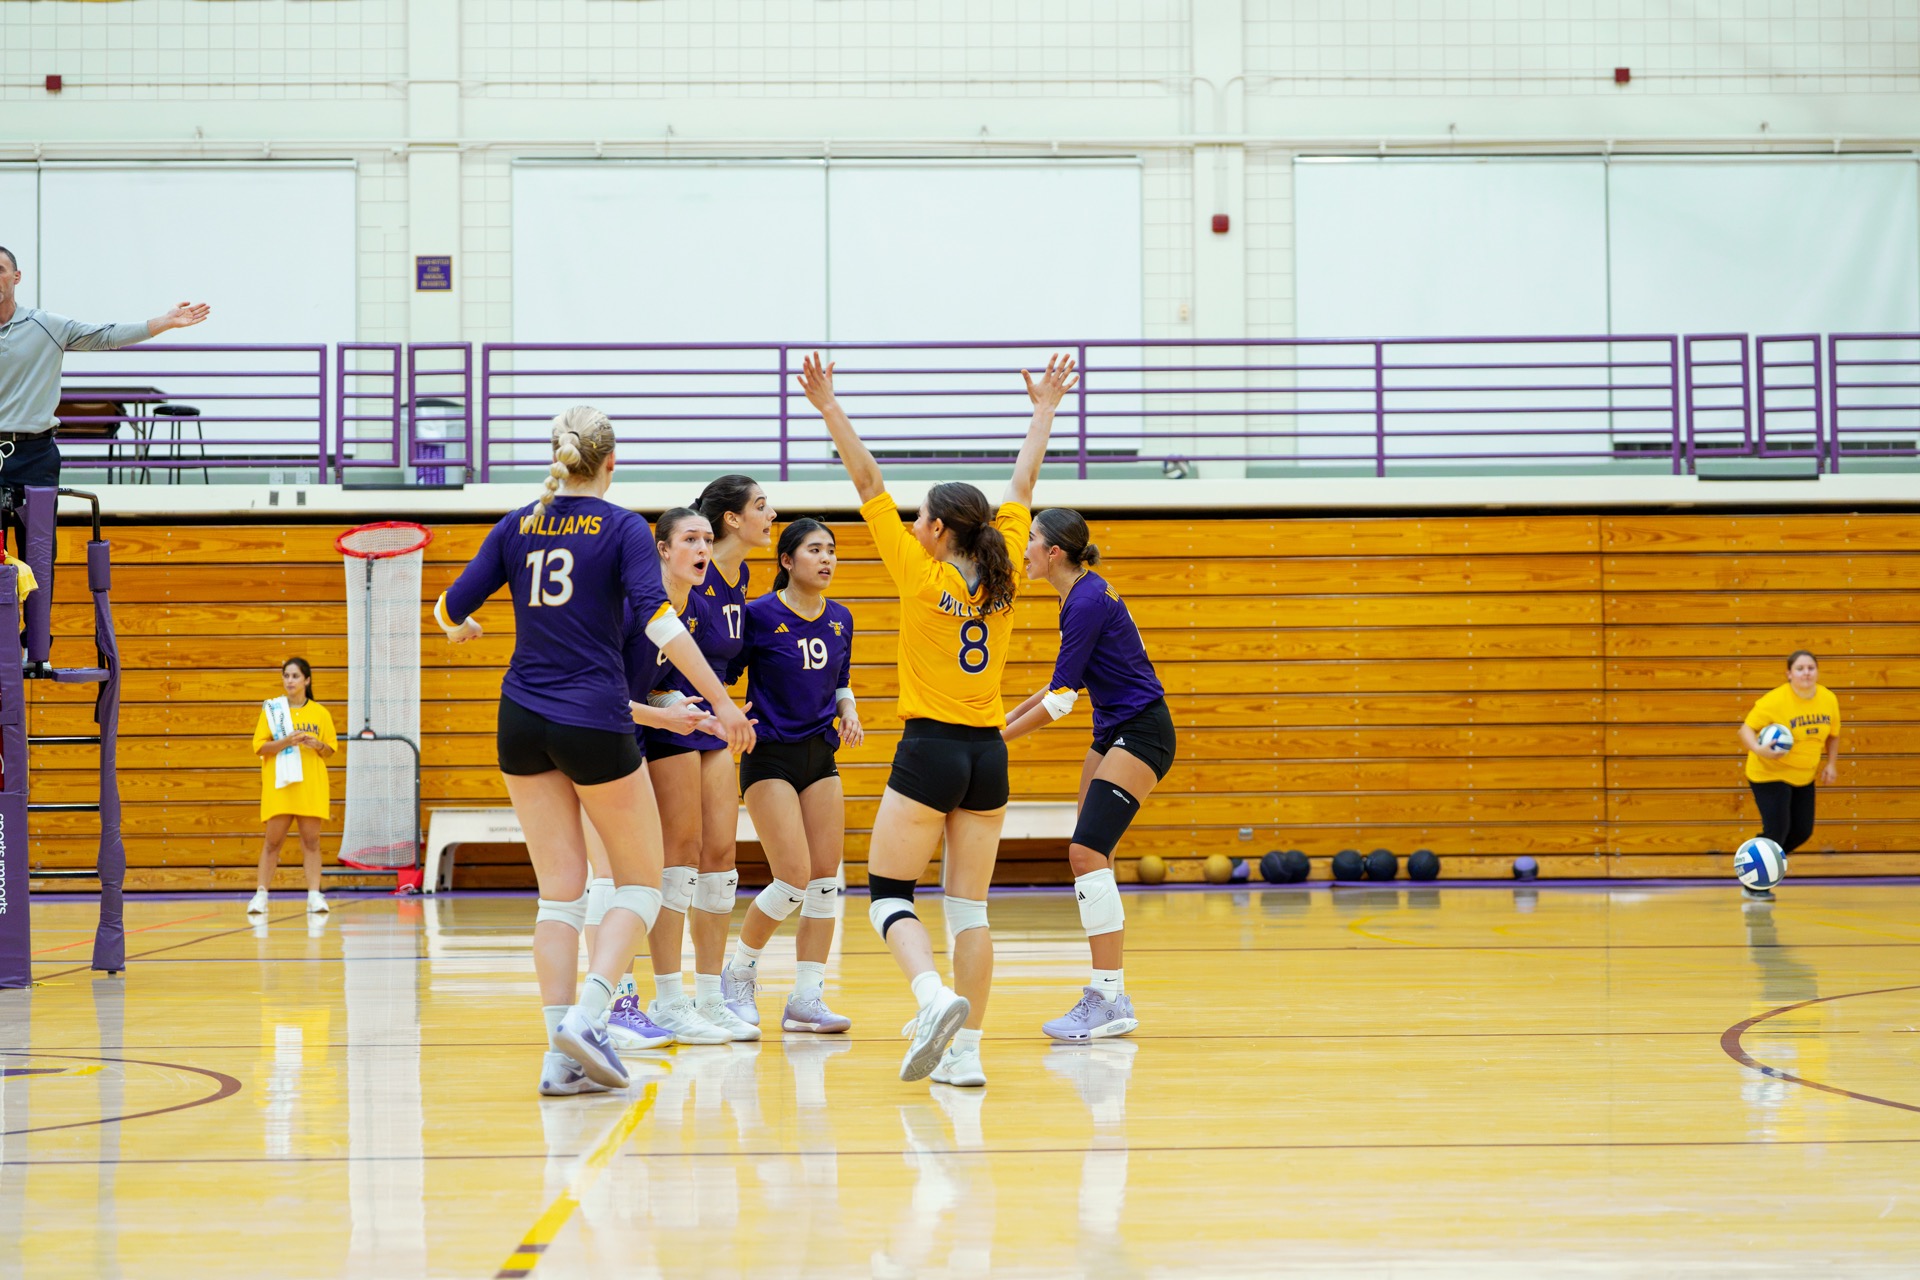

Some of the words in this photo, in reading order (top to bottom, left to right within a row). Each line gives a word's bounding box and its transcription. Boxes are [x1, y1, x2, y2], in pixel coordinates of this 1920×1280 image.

[525, 547, 575, 608] 13
[722, 603, 742, 639] 17
[797, 637, 829, 670] 19
[957, 618, 991, 675] 8
